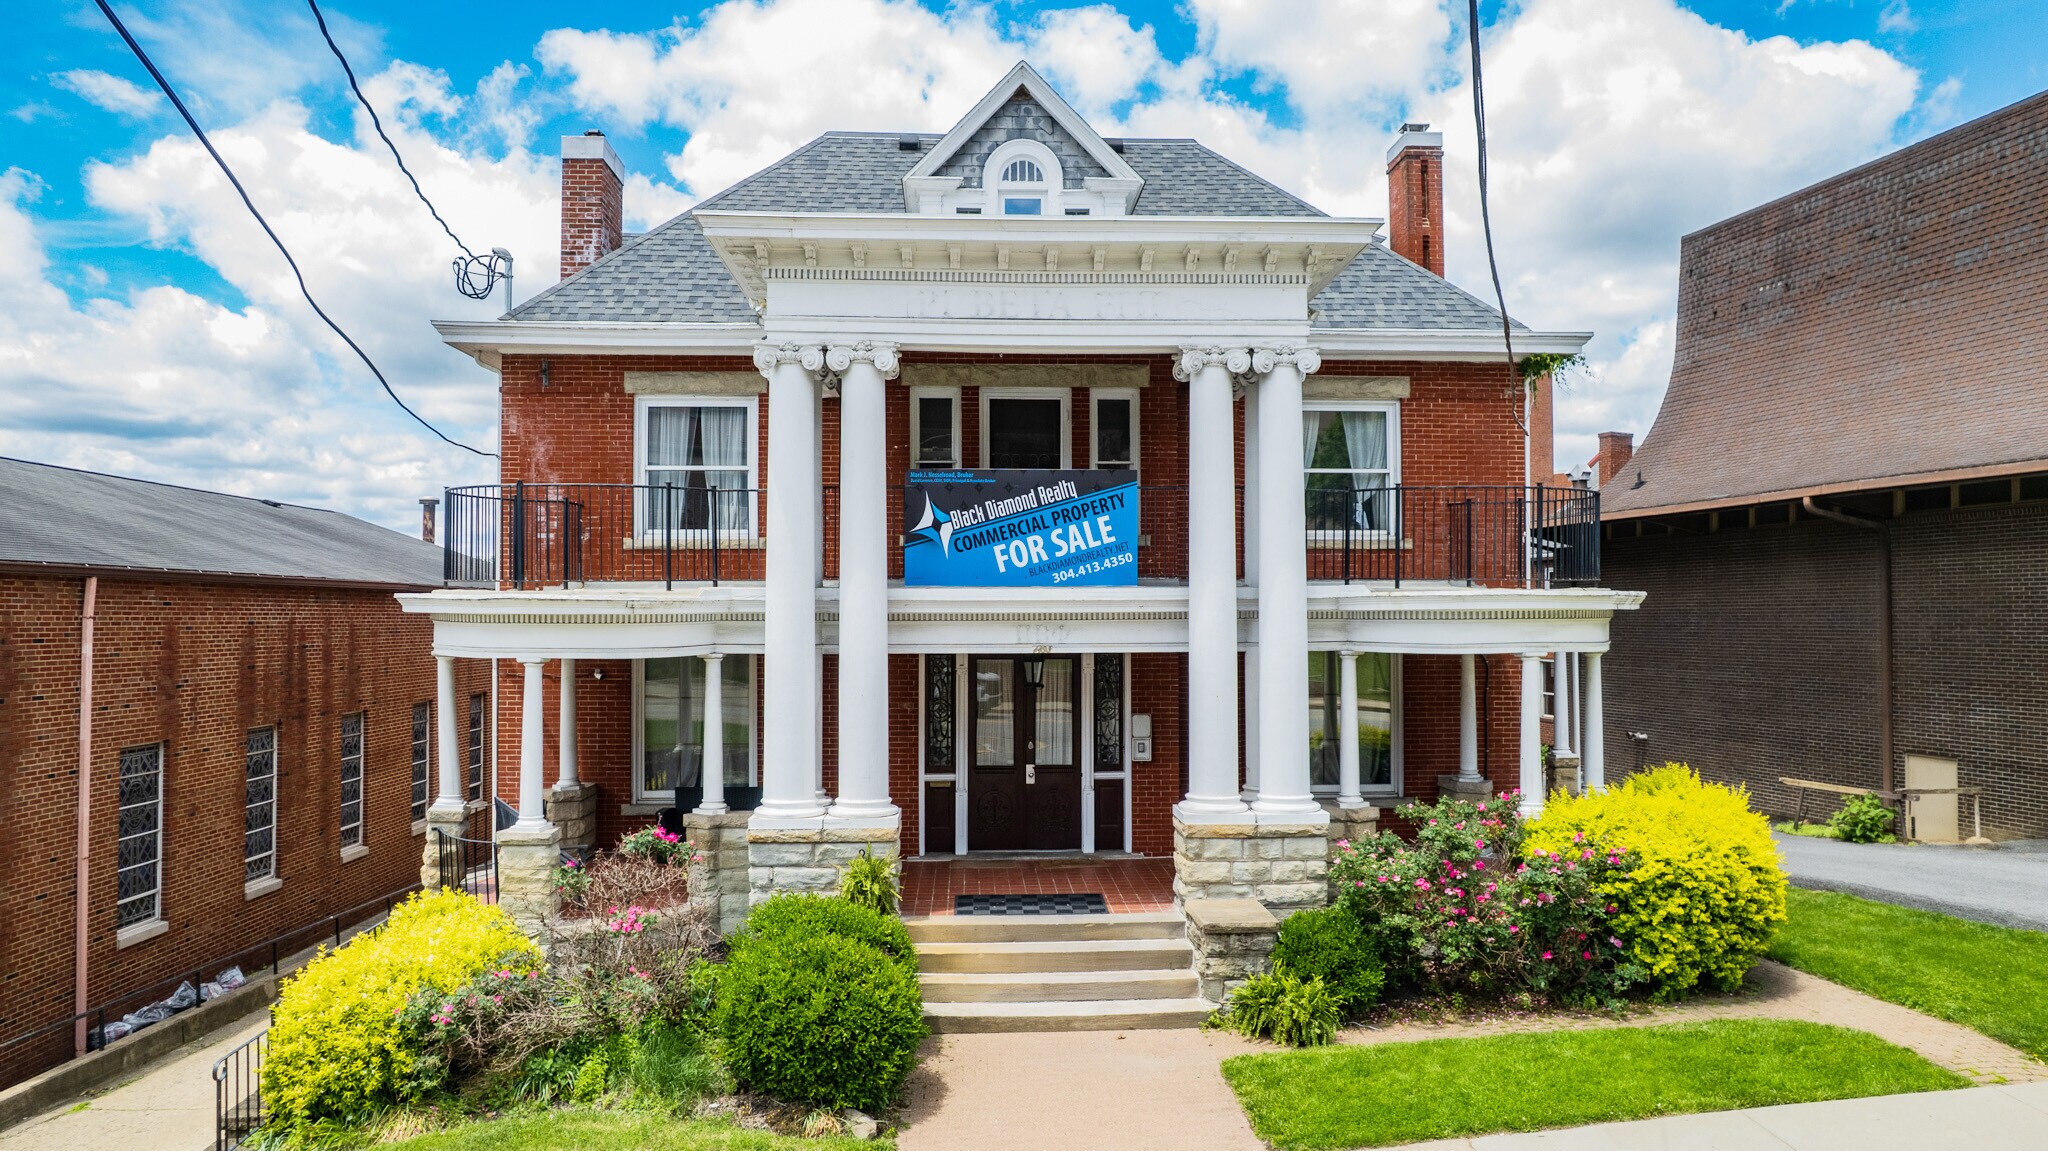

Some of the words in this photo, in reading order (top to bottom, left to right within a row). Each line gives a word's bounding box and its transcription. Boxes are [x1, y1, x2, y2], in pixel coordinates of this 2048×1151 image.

[949, 503, 983, 530] Black
[987, 491, 1037, 521] Diamond
[1039, 479, 1078, 505] Realty
[954, 514, 1050, 553] COMMERCIAL
[1051, 492, 1126, 527] PROPERTY
[993, 534, 1049, 573] FOR
[1050, 515, 1117, 557] SALE
[1028, 541, 1129, 578] BLACKDIAMONDREALTY.NET
[1052, 552, 1134, 584] 304.413.4350
